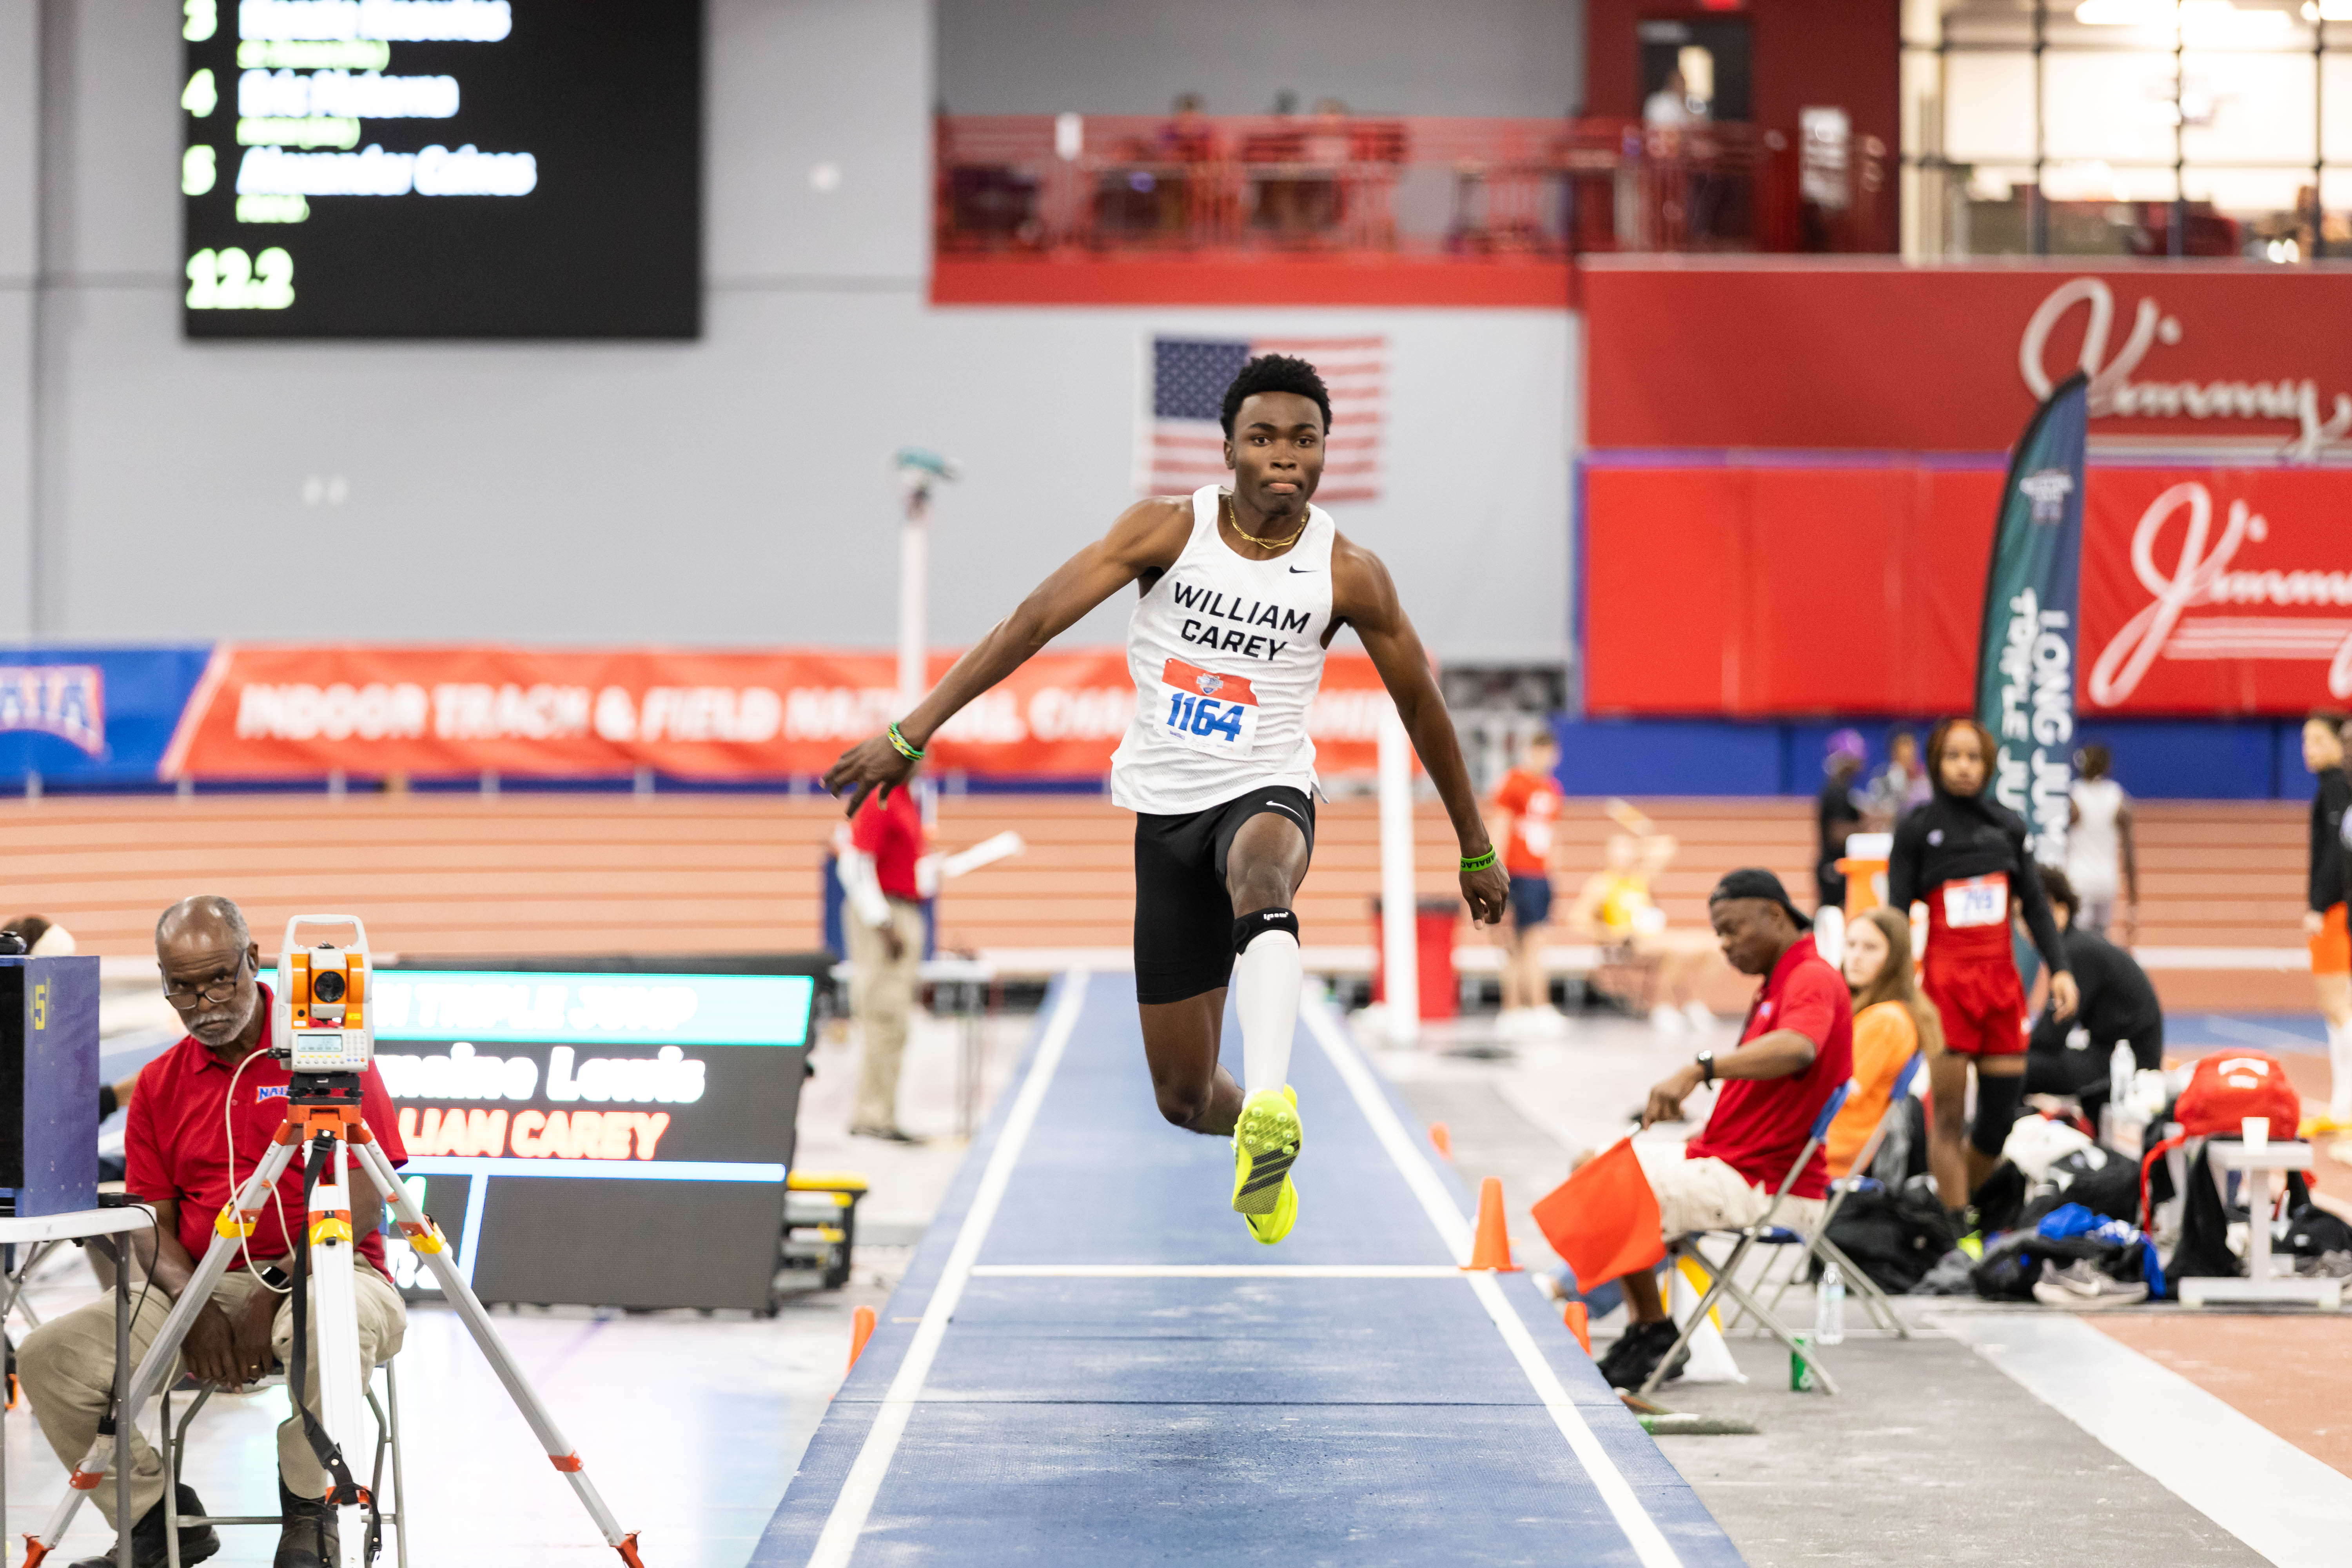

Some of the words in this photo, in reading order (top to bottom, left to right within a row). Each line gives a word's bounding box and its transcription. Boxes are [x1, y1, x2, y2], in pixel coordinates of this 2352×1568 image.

[181, 69, 217, 117] 4
[1174, 582, 1311, 633] WILLIAM
[1181, 619, 1288, 661] CAREY
[1167, 692, 1245, 742] 1164
[35, 985, 45, 1030] 5
[398, 1107, 510, 1157] LIAM
[510, 1109, 671, 1161] CAREY
